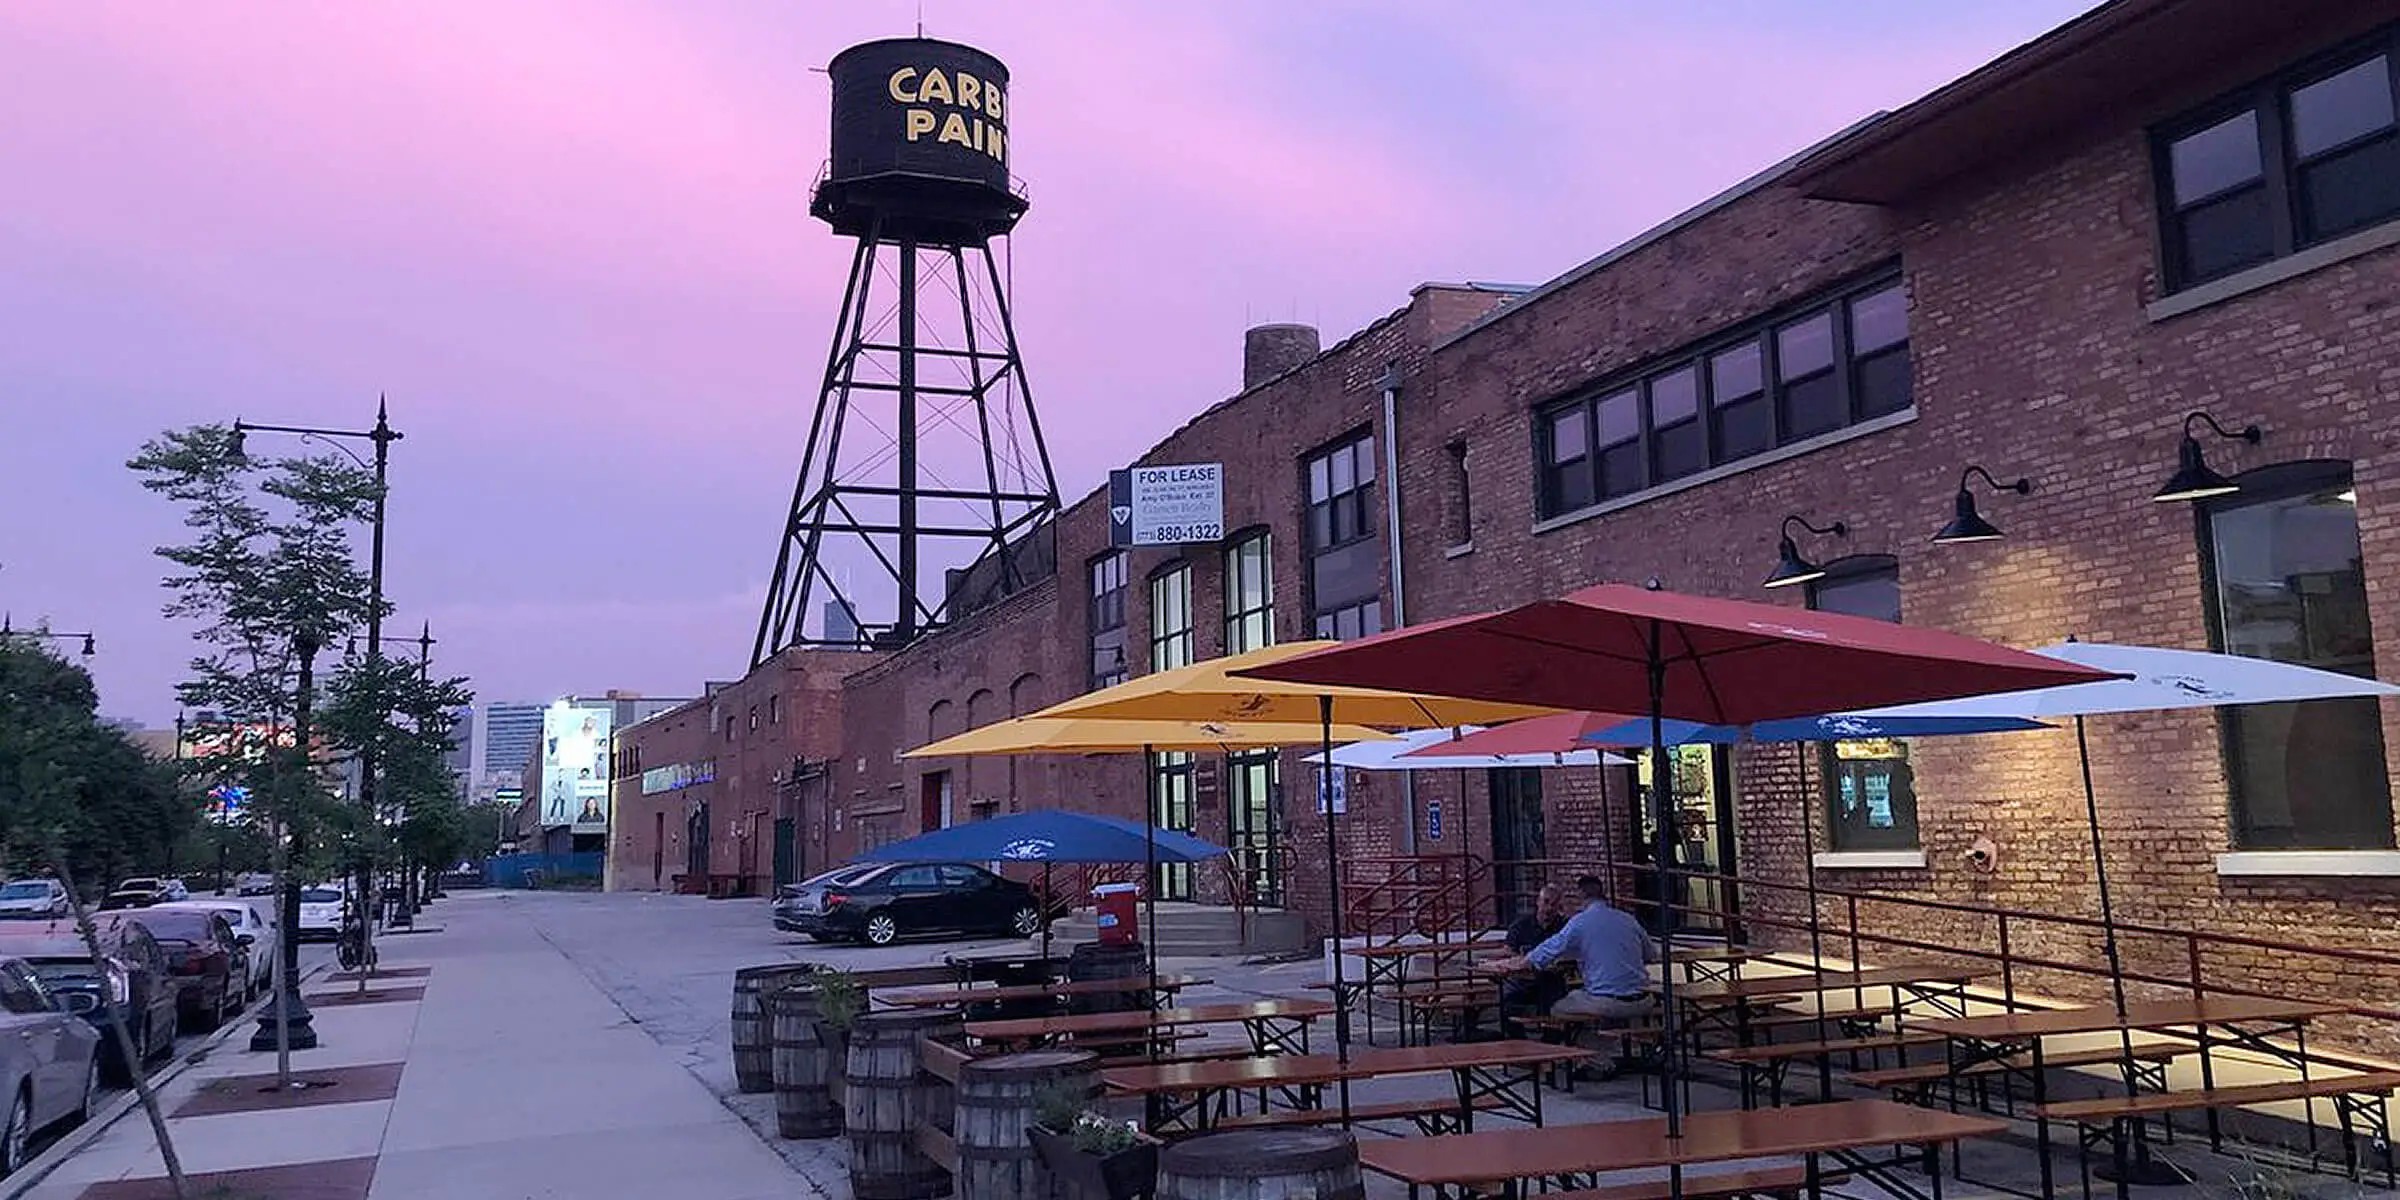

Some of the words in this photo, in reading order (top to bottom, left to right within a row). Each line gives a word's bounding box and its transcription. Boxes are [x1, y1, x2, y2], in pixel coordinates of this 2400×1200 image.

[1139, 471, 1167, 484] FOR
[1171, 467, 1215, 482] LEASE
[1157, 524, 1220, 542] 880-1322
